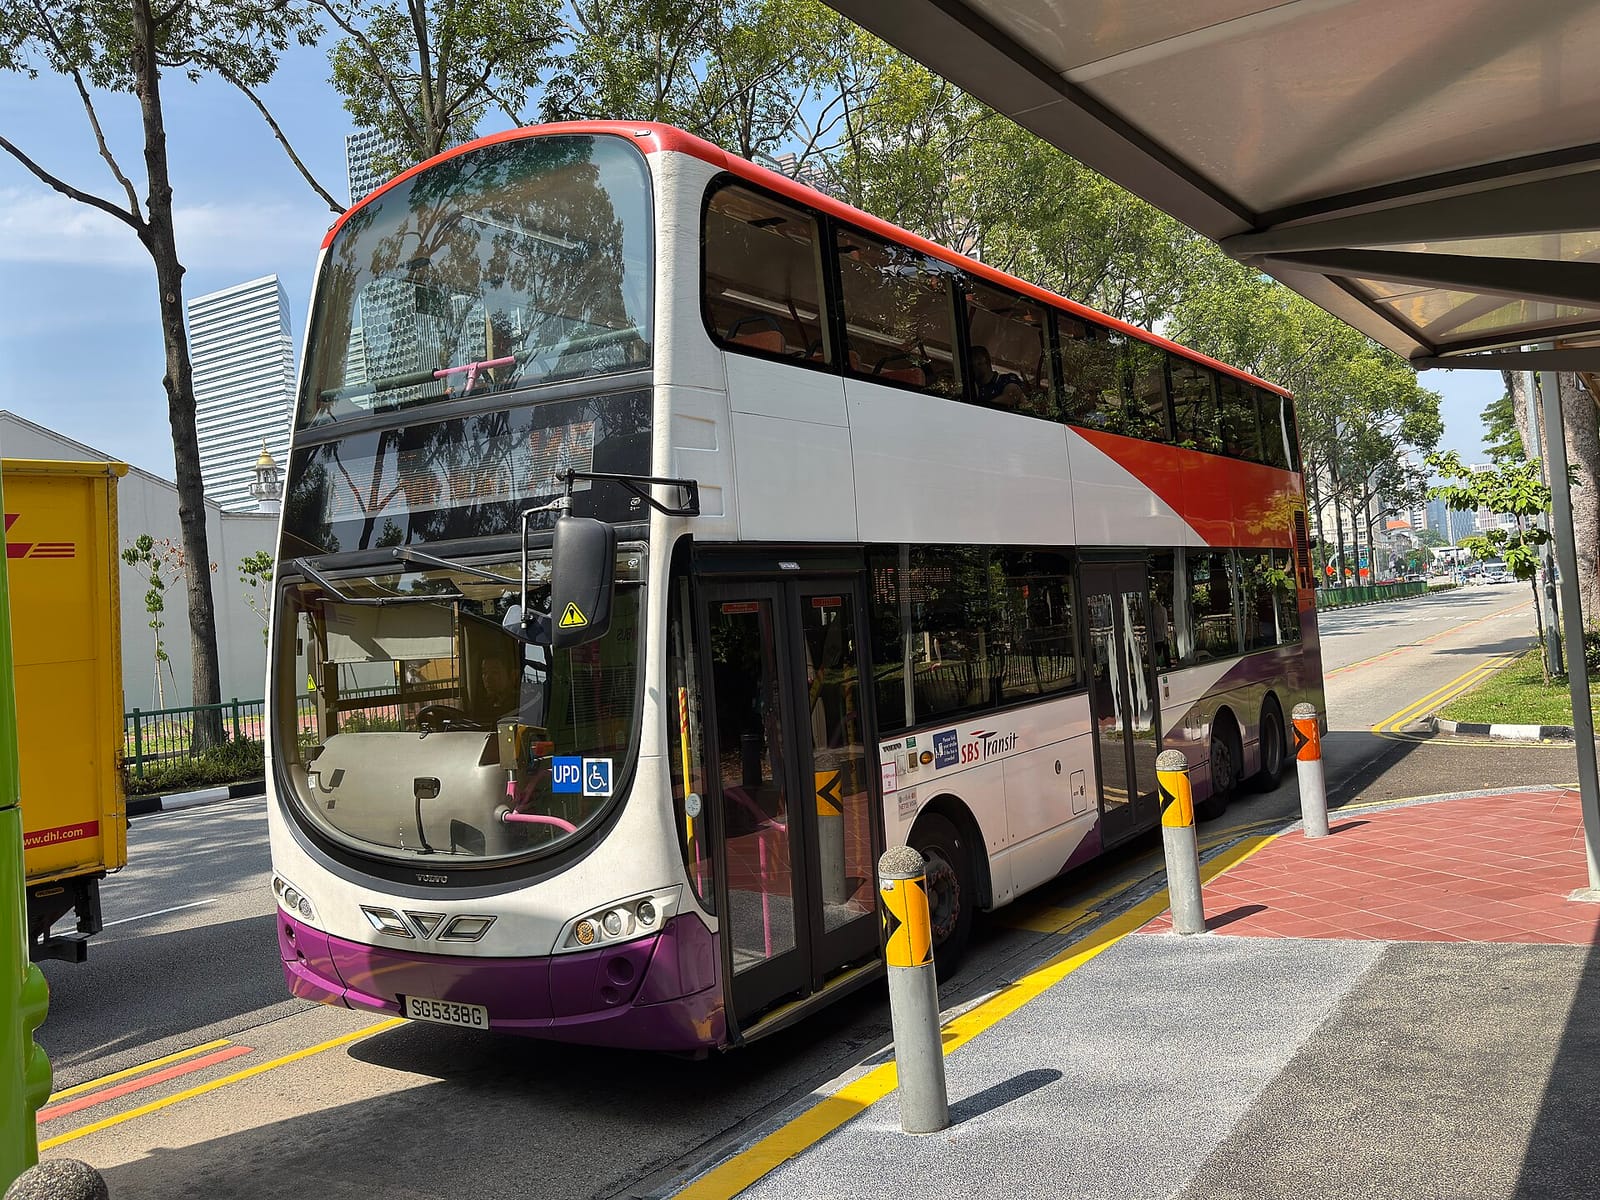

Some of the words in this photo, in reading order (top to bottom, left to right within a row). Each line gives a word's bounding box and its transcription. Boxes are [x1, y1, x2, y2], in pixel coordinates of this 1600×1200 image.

[961, 741, 980, 765] SBS
[977, 731, 1019, 761] Transit
[553, 765, 580, 784] UPD
[24, 829, 83, 845] ww.dhl.com
[412, 998, 482, 1026] SG5338G
